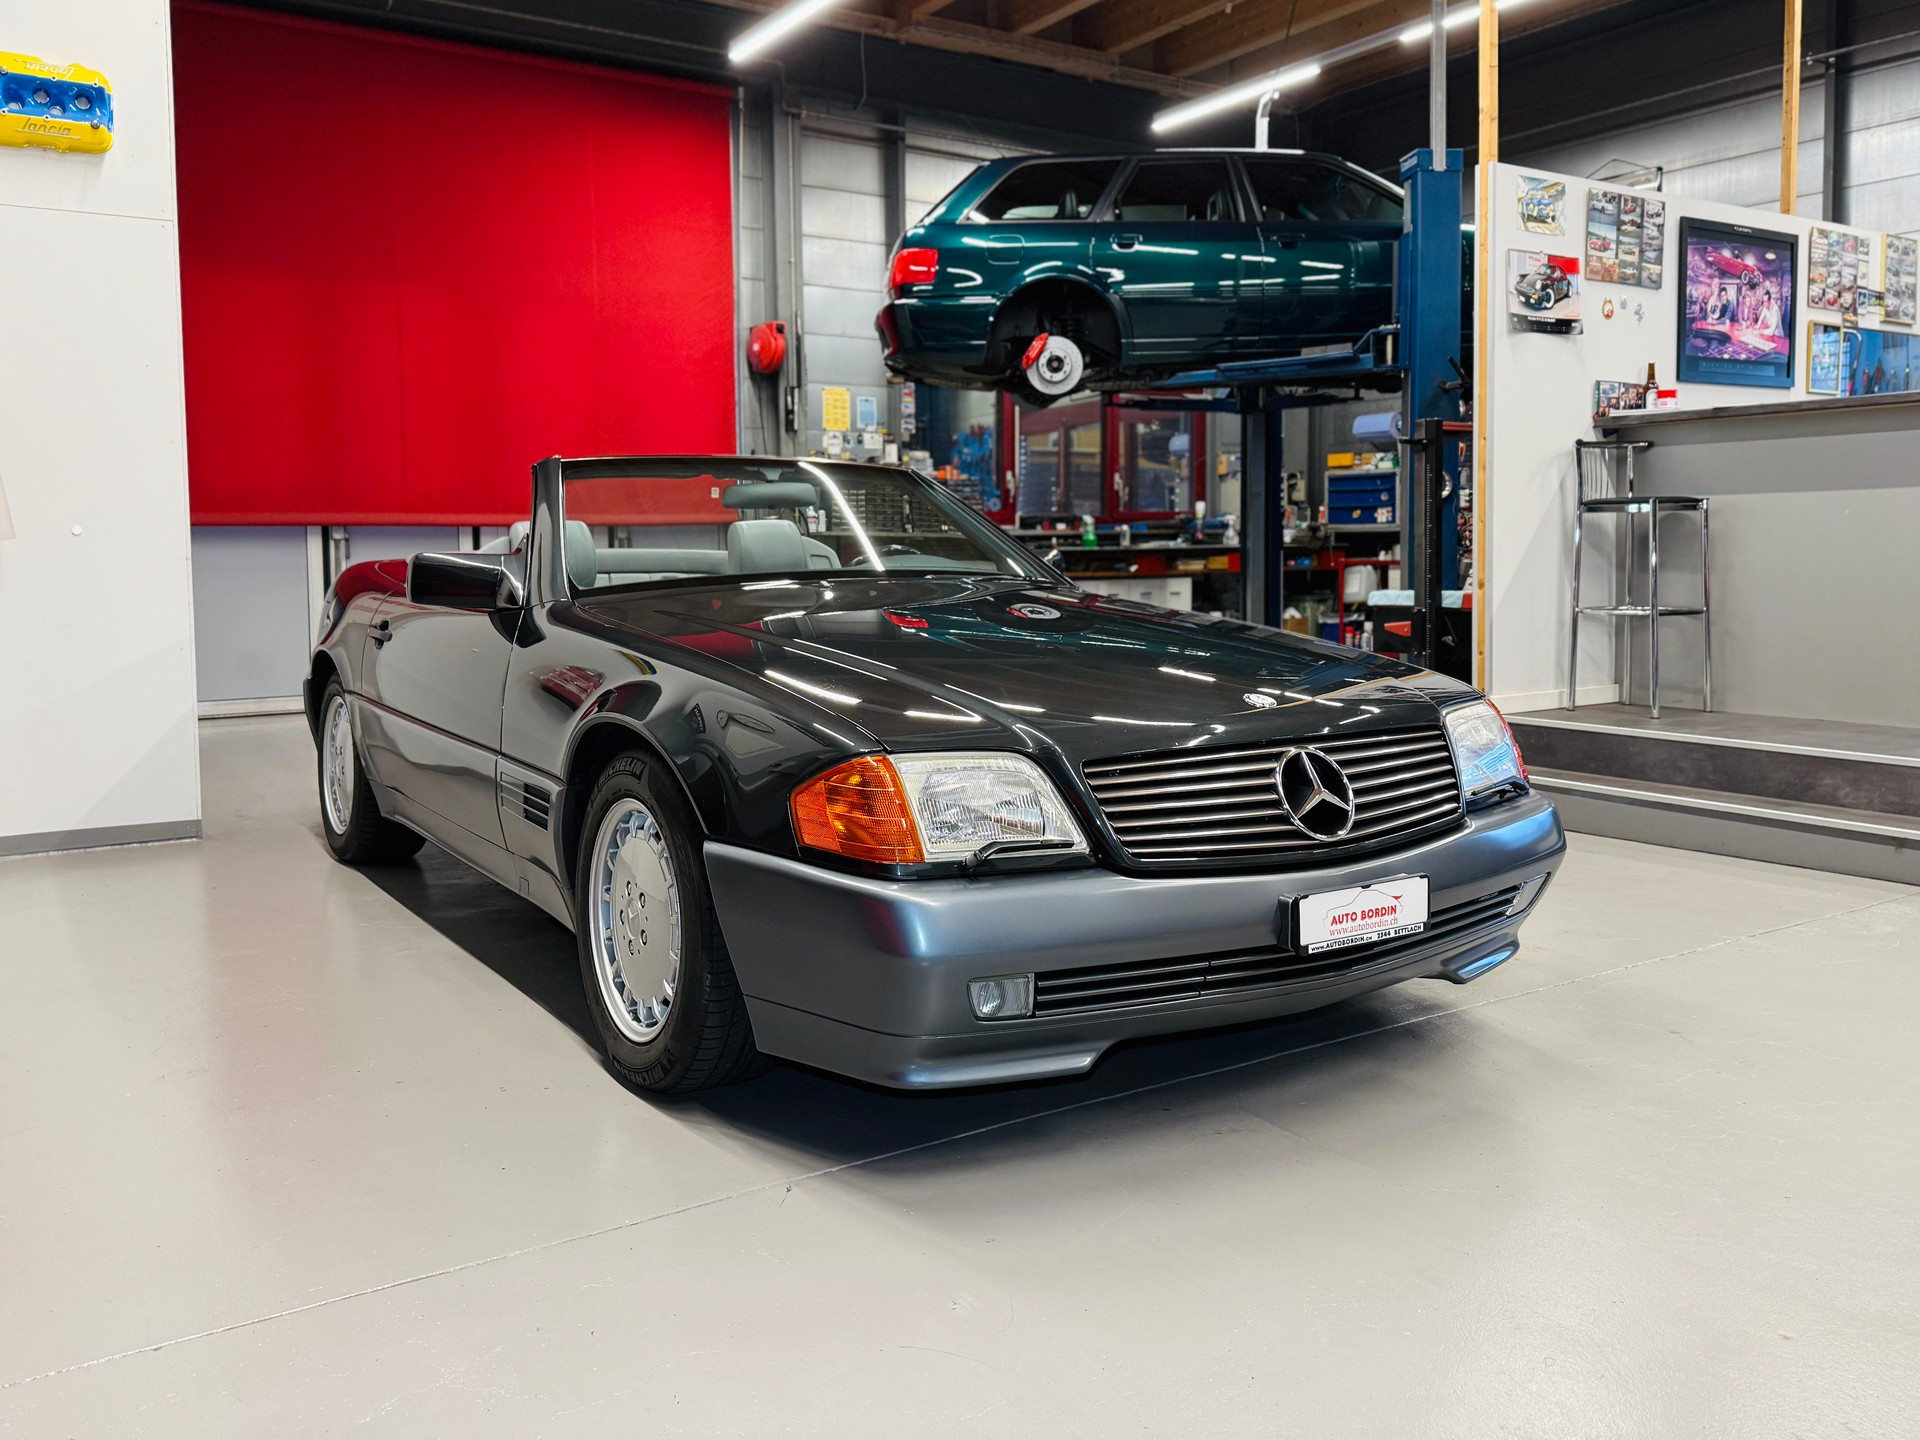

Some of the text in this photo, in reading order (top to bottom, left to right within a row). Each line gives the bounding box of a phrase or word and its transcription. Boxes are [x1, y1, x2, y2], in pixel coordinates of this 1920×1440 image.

[1331, 905, 1397, 926] AUTO BORDIN
[1329, 916, 1399, 936] www.autobordin.ch
[1394, 924, 1422, 936] BETTLACH
